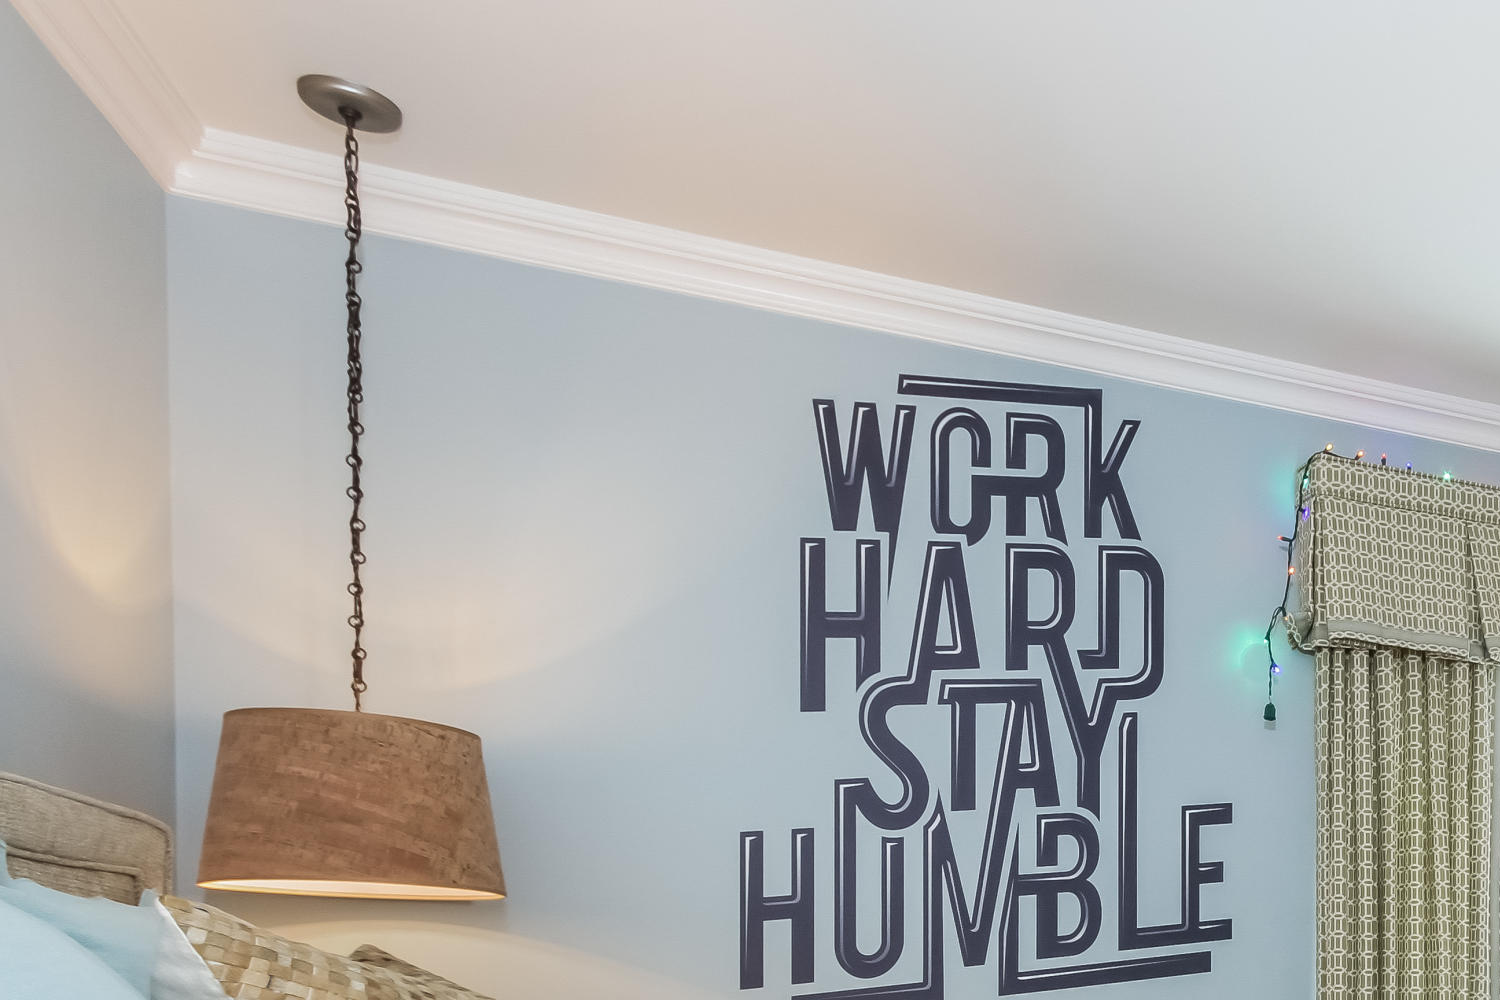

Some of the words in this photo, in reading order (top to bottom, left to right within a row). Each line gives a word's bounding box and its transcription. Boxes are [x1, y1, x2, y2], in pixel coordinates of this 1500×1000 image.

[812, 374, 1142, 550] WORK
[800, 537, 1165, 712] HARD
[835, 668, 1115, 831] STAY
